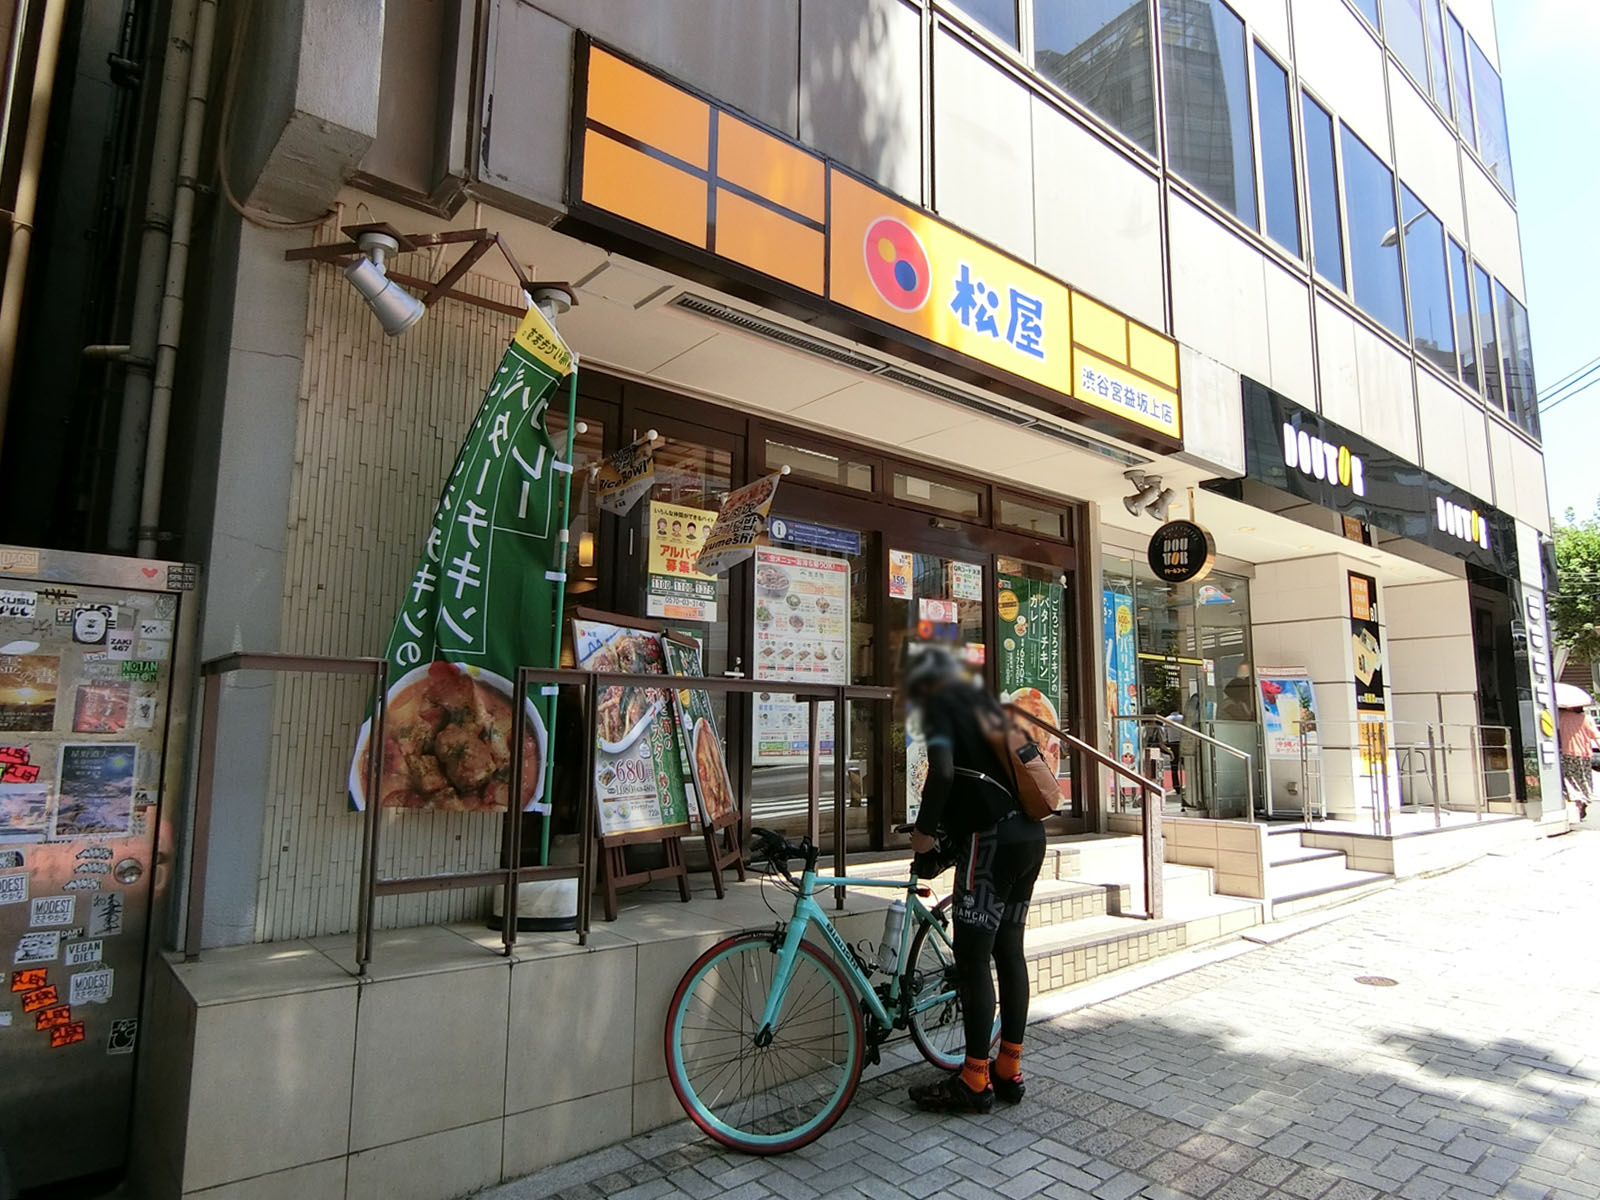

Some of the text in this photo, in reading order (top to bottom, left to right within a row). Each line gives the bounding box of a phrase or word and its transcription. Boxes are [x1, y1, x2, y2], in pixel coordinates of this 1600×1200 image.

[949, 263, 1045, 360] 松屋
[1083, 368, 1172, 424] 渋谷宮益坂上店
[1284, 422, 1365, 497] DOUTOR
[1436, 496, 1488, 550] DOUTOR
[893, 576, 905, 586] 150
[1030, 594, 1039, 635] カレー
[1040, 596, 1050, 678] バターチキン
[36, 900, 71, 915] MODEST
[956, 907, 989, 924] IANCHI
[69, 942, 101, 954] VEGAN
[73, 952, 95, 963] DIET
[826, 922, 860, 971] Bianchi
[75, 974, 109, 990] MODEST
